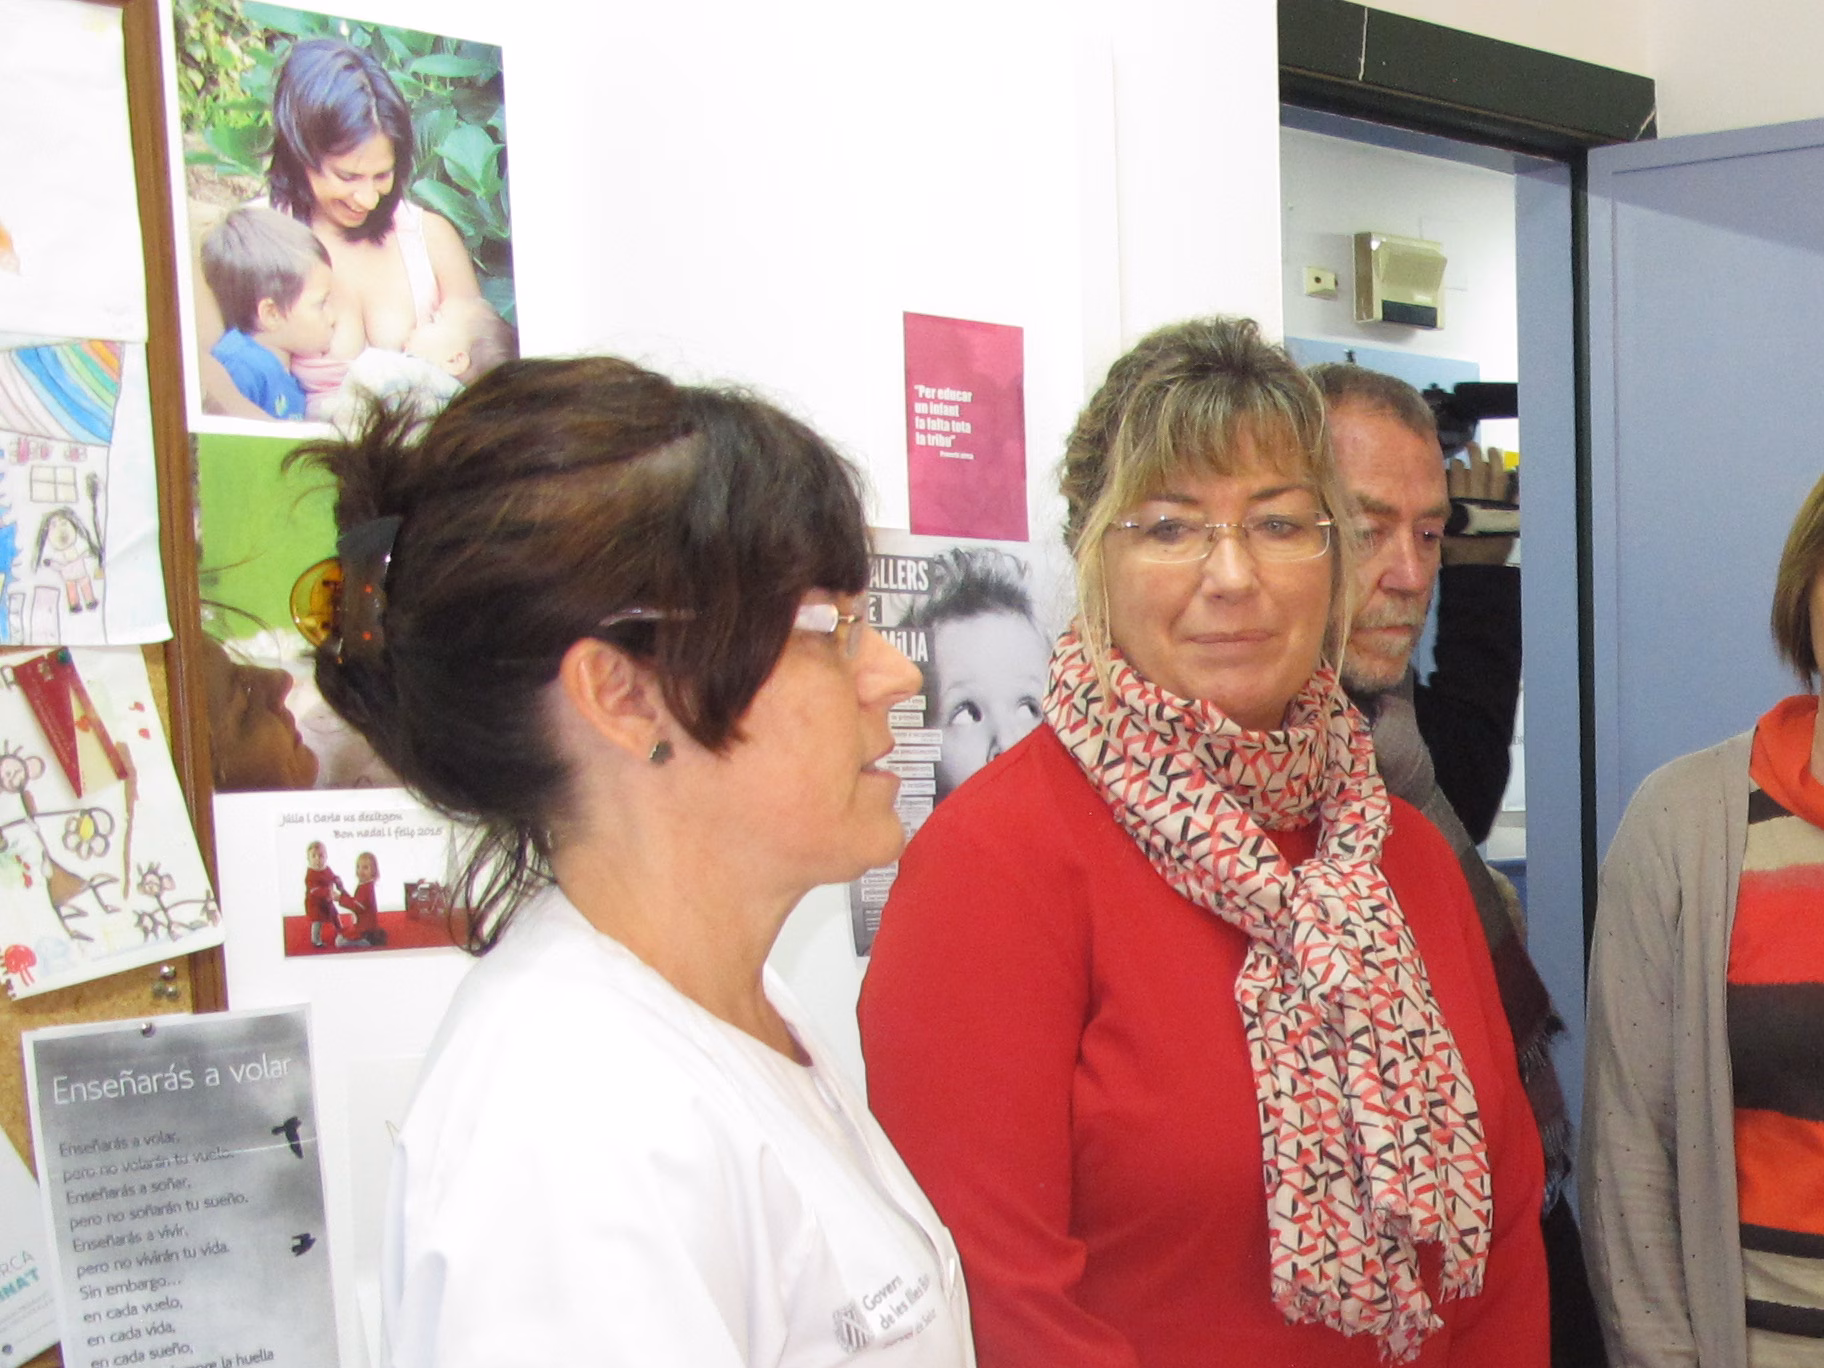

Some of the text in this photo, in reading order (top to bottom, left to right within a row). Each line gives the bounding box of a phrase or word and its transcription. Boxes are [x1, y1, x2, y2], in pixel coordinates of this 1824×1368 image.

[937, 388, 973, 402] educar
[869, 558, 929, 591] ALLERS
[53, 1053, 291, 1105] Enseñarás a volar
[59, 1134, 129, 1158] Enseñarás
[133, 1138, 140, 1147] a
[174, 1153, 189, 1166] tu
[66, 1184, 135, 1205] Enseñarás
[140, 1184, 147, 1195] a
[69, 1192, 249, 1232] pero no soñarán tu sueño.
[72, 1231, 142, 1253] Enseñarás
[147, 1230, 154, 1241] a
[77, 1261, 109, 1279] pero
[114, 1258, 132, 1271] no
[136, 1249, 180, 1266] vivirán
[183, 1247, 197, 1259] tu
[79, 1285, 102, 1300] Sin
[84, 1296, 183, 1323] en cada vuelo,
[87, 1335, 105, 1347] en
[110, 1328, 141, 1343] cada
[113, 1350, 145, 1366] cada
[149, 1342, 193, 1360] sueño,
[221, 1356, 232, 1368] la
[236, 1349, 274, 1367] huella
